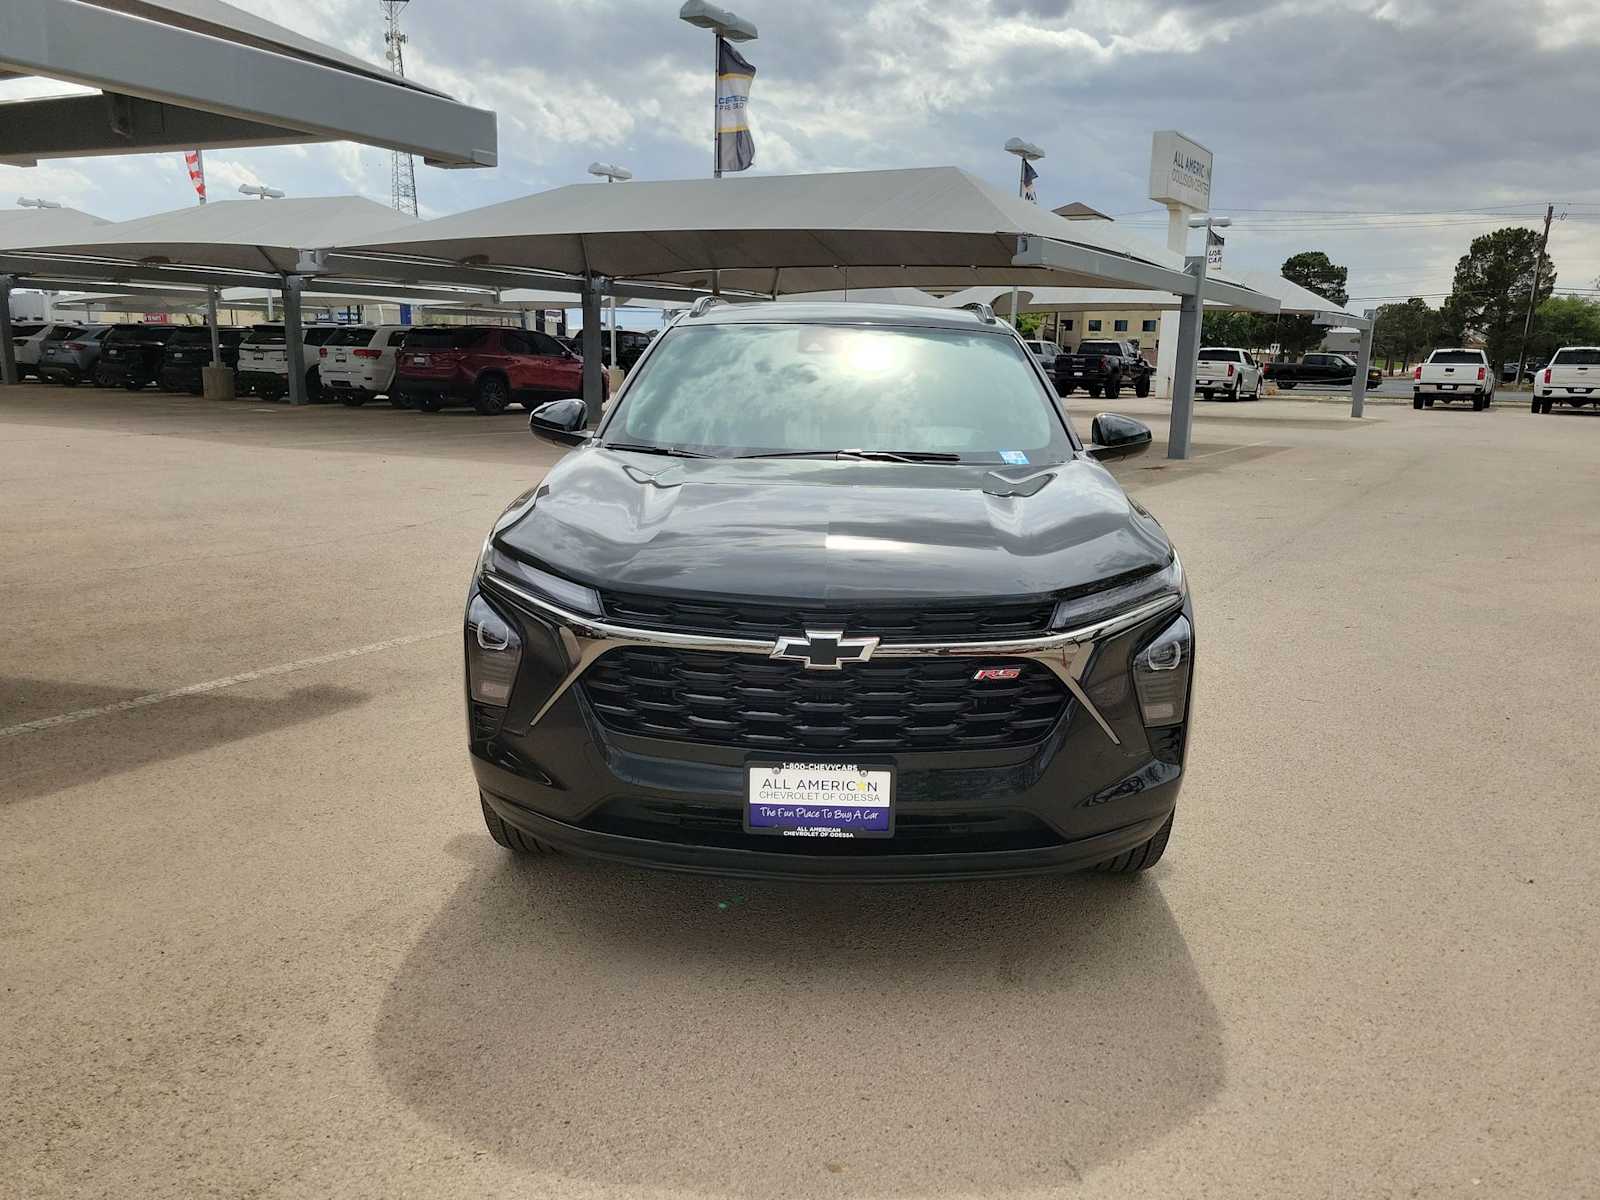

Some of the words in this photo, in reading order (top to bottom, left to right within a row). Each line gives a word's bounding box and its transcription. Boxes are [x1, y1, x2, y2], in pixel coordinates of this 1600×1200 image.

[973, 668, 1021, 680] RS
[762, 778, 792, 790] ALL
[796, 779, 878, 792] AMERICN
[759, 790, 819, 801] CHEVROLET
[822, 791, 836, 801] OF
[838, 791, 880, 802] ODESSA
[760, 806, 776, 817] The
[777, 807, 795, 817] Fun
[796, 807, 820, 818] Place
[821, 808, 832, 819] To
[834, 809, 852, 822] Buy
[853, 810, 861, 820] A
[863, 810, 880, 820] Car
